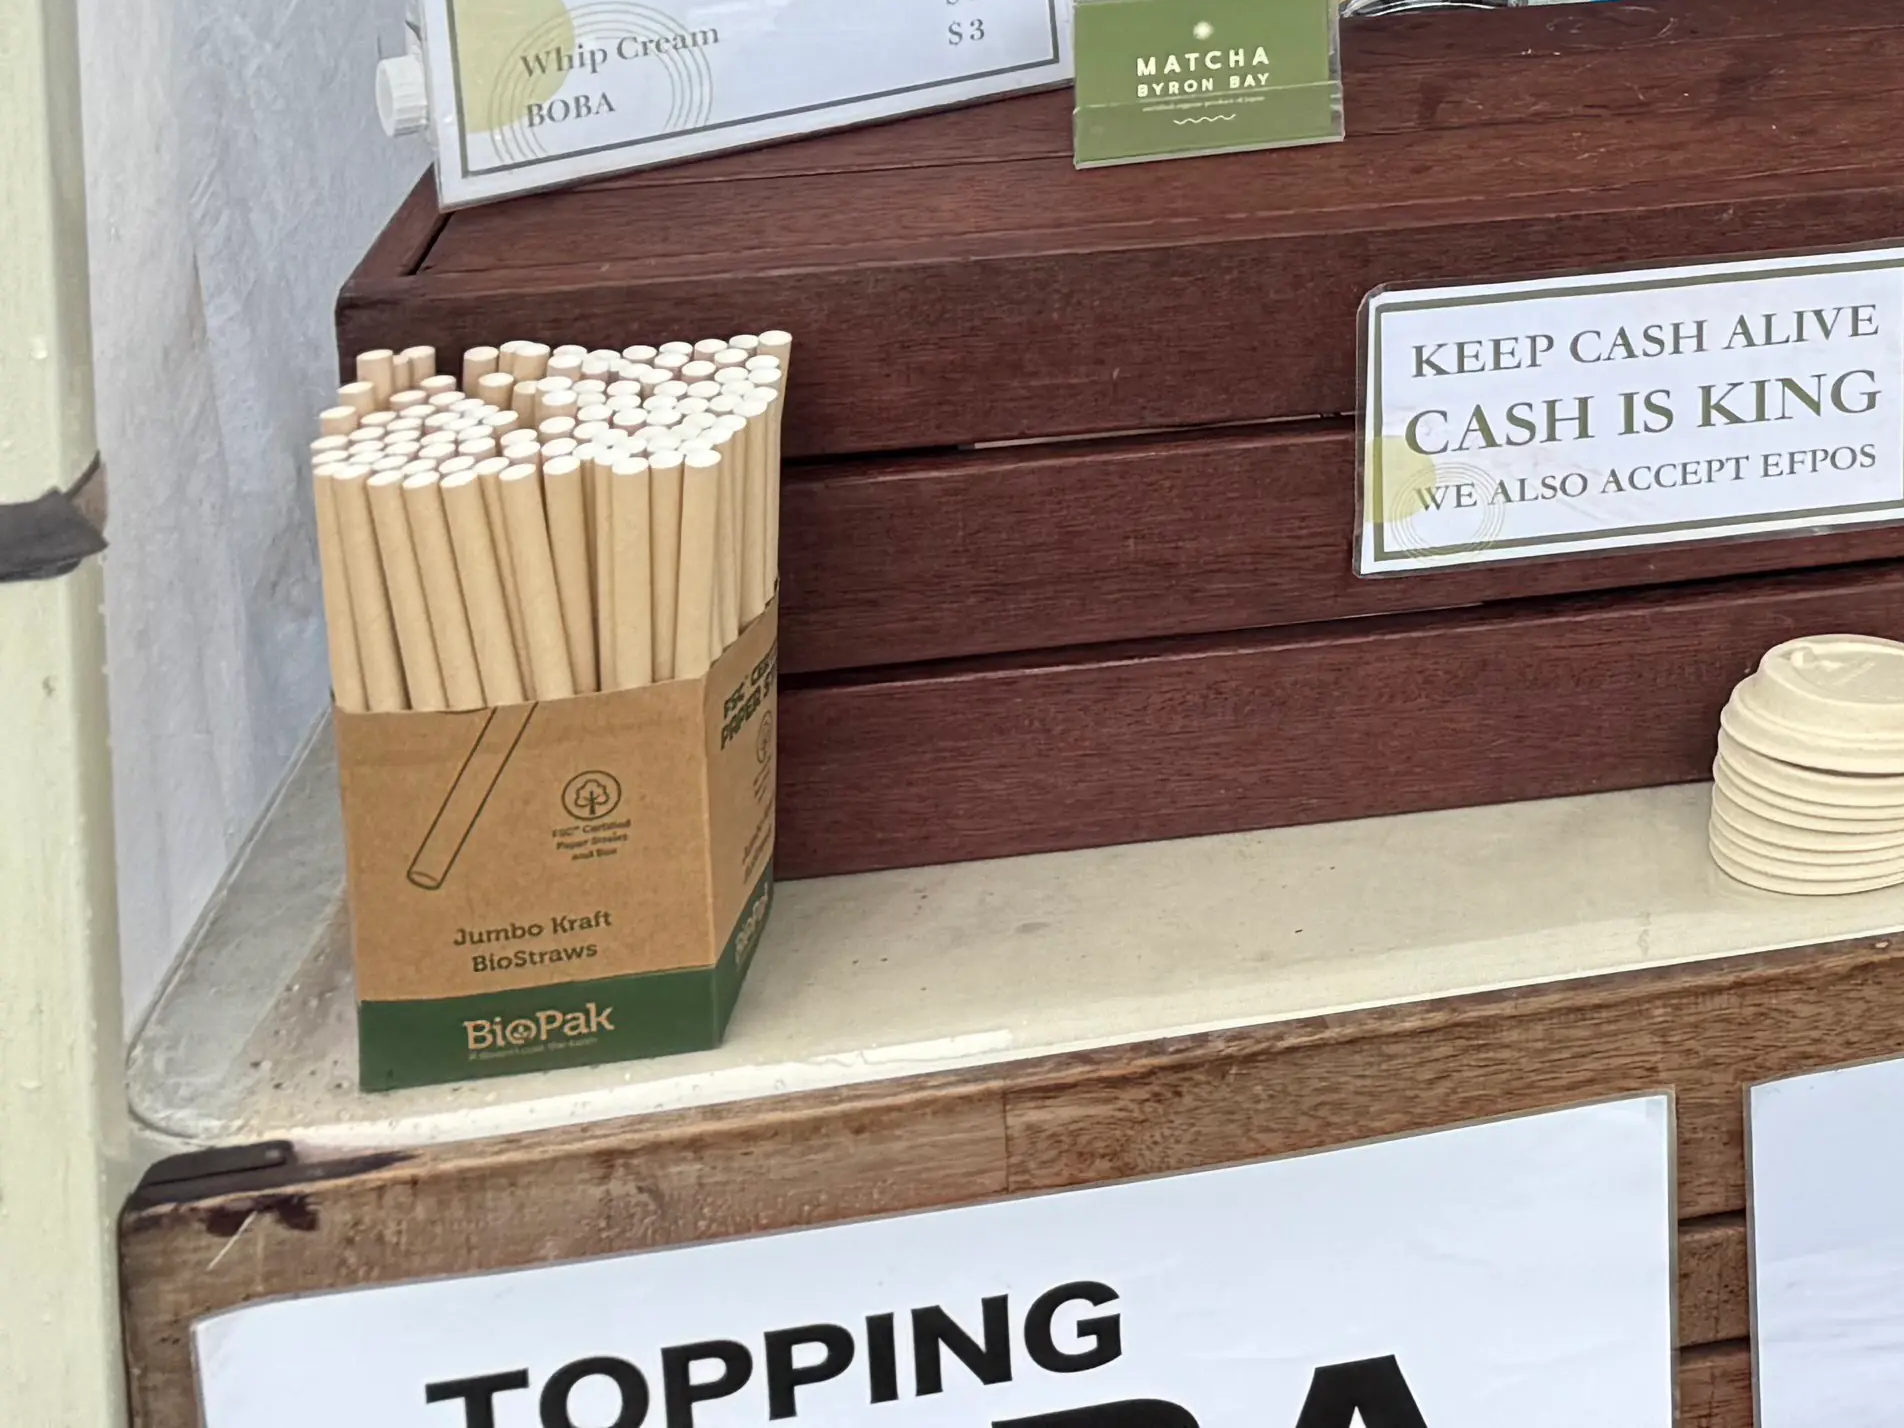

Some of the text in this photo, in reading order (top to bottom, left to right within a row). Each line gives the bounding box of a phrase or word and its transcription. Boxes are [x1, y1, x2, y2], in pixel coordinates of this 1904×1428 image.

[520, 46, 608, 80] Whip
[616, 27, 720, 62] Cream
[1137, 47, 1269, 76] MATCHA
[1138, 73, 1269, 97] BYRON BAY
[526, 92, 616, 130] BOBA
[1411, 303, 1880, 379] KEEP CASH ALIVE
[1405, 368, 1883, 457] CASH IS KING
[1412, 443, 1877, 513] WE ALSO ACCEPT EFPOS
[453, 911, 612, 945] Jumbo Kraft
[472, 944, 598, 972] BioStraws
[463, 1002, 615, 1050] BioPak
[425, 1278, 1123, 1428] TOPPING
